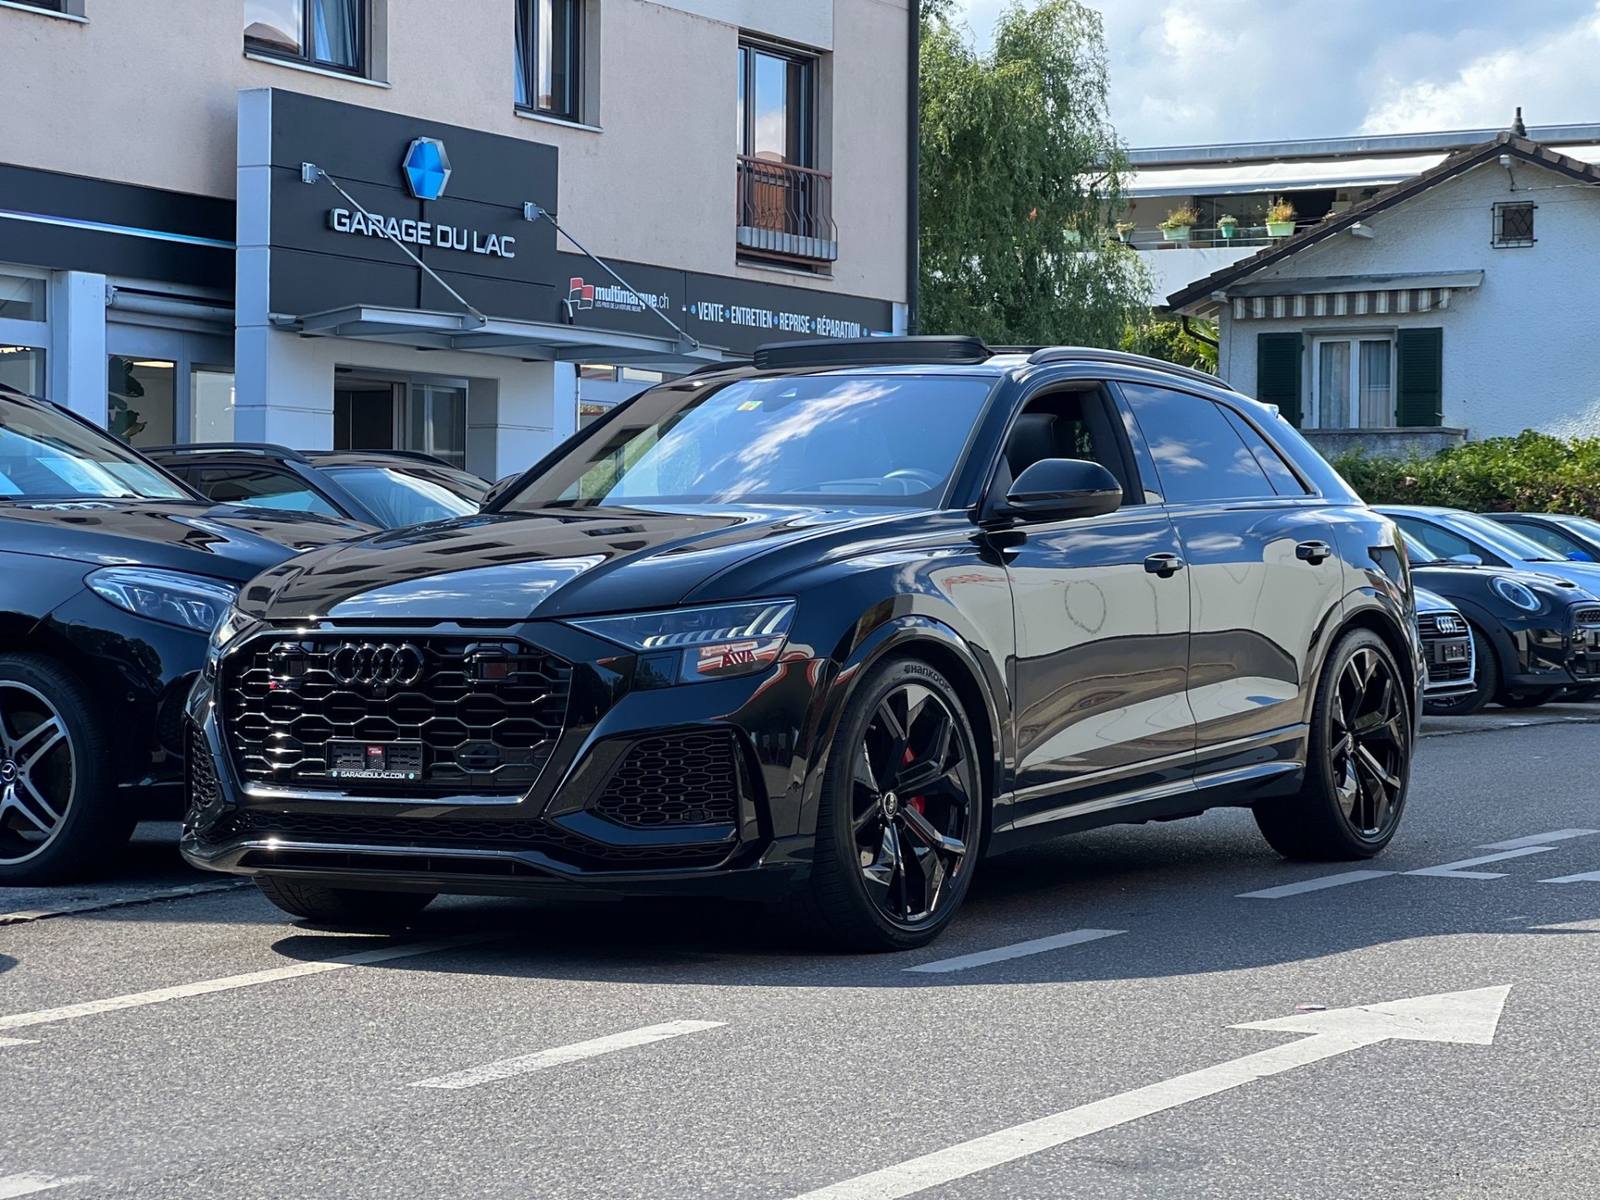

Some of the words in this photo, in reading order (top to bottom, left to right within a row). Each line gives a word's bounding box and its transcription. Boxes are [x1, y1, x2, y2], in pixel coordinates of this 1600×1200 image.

[331, 208, 432, 246] GARAGE
[436, 224, 468, 251] DU
[472, 230, 516, 259] LAC
[697, 301, 724, 323] VENTE
[730, 305, 773, 329] ENTRETIEN
[779, 311, 811, 334] REPRISE
[816, 314, 861, 339] RÉPARATION
